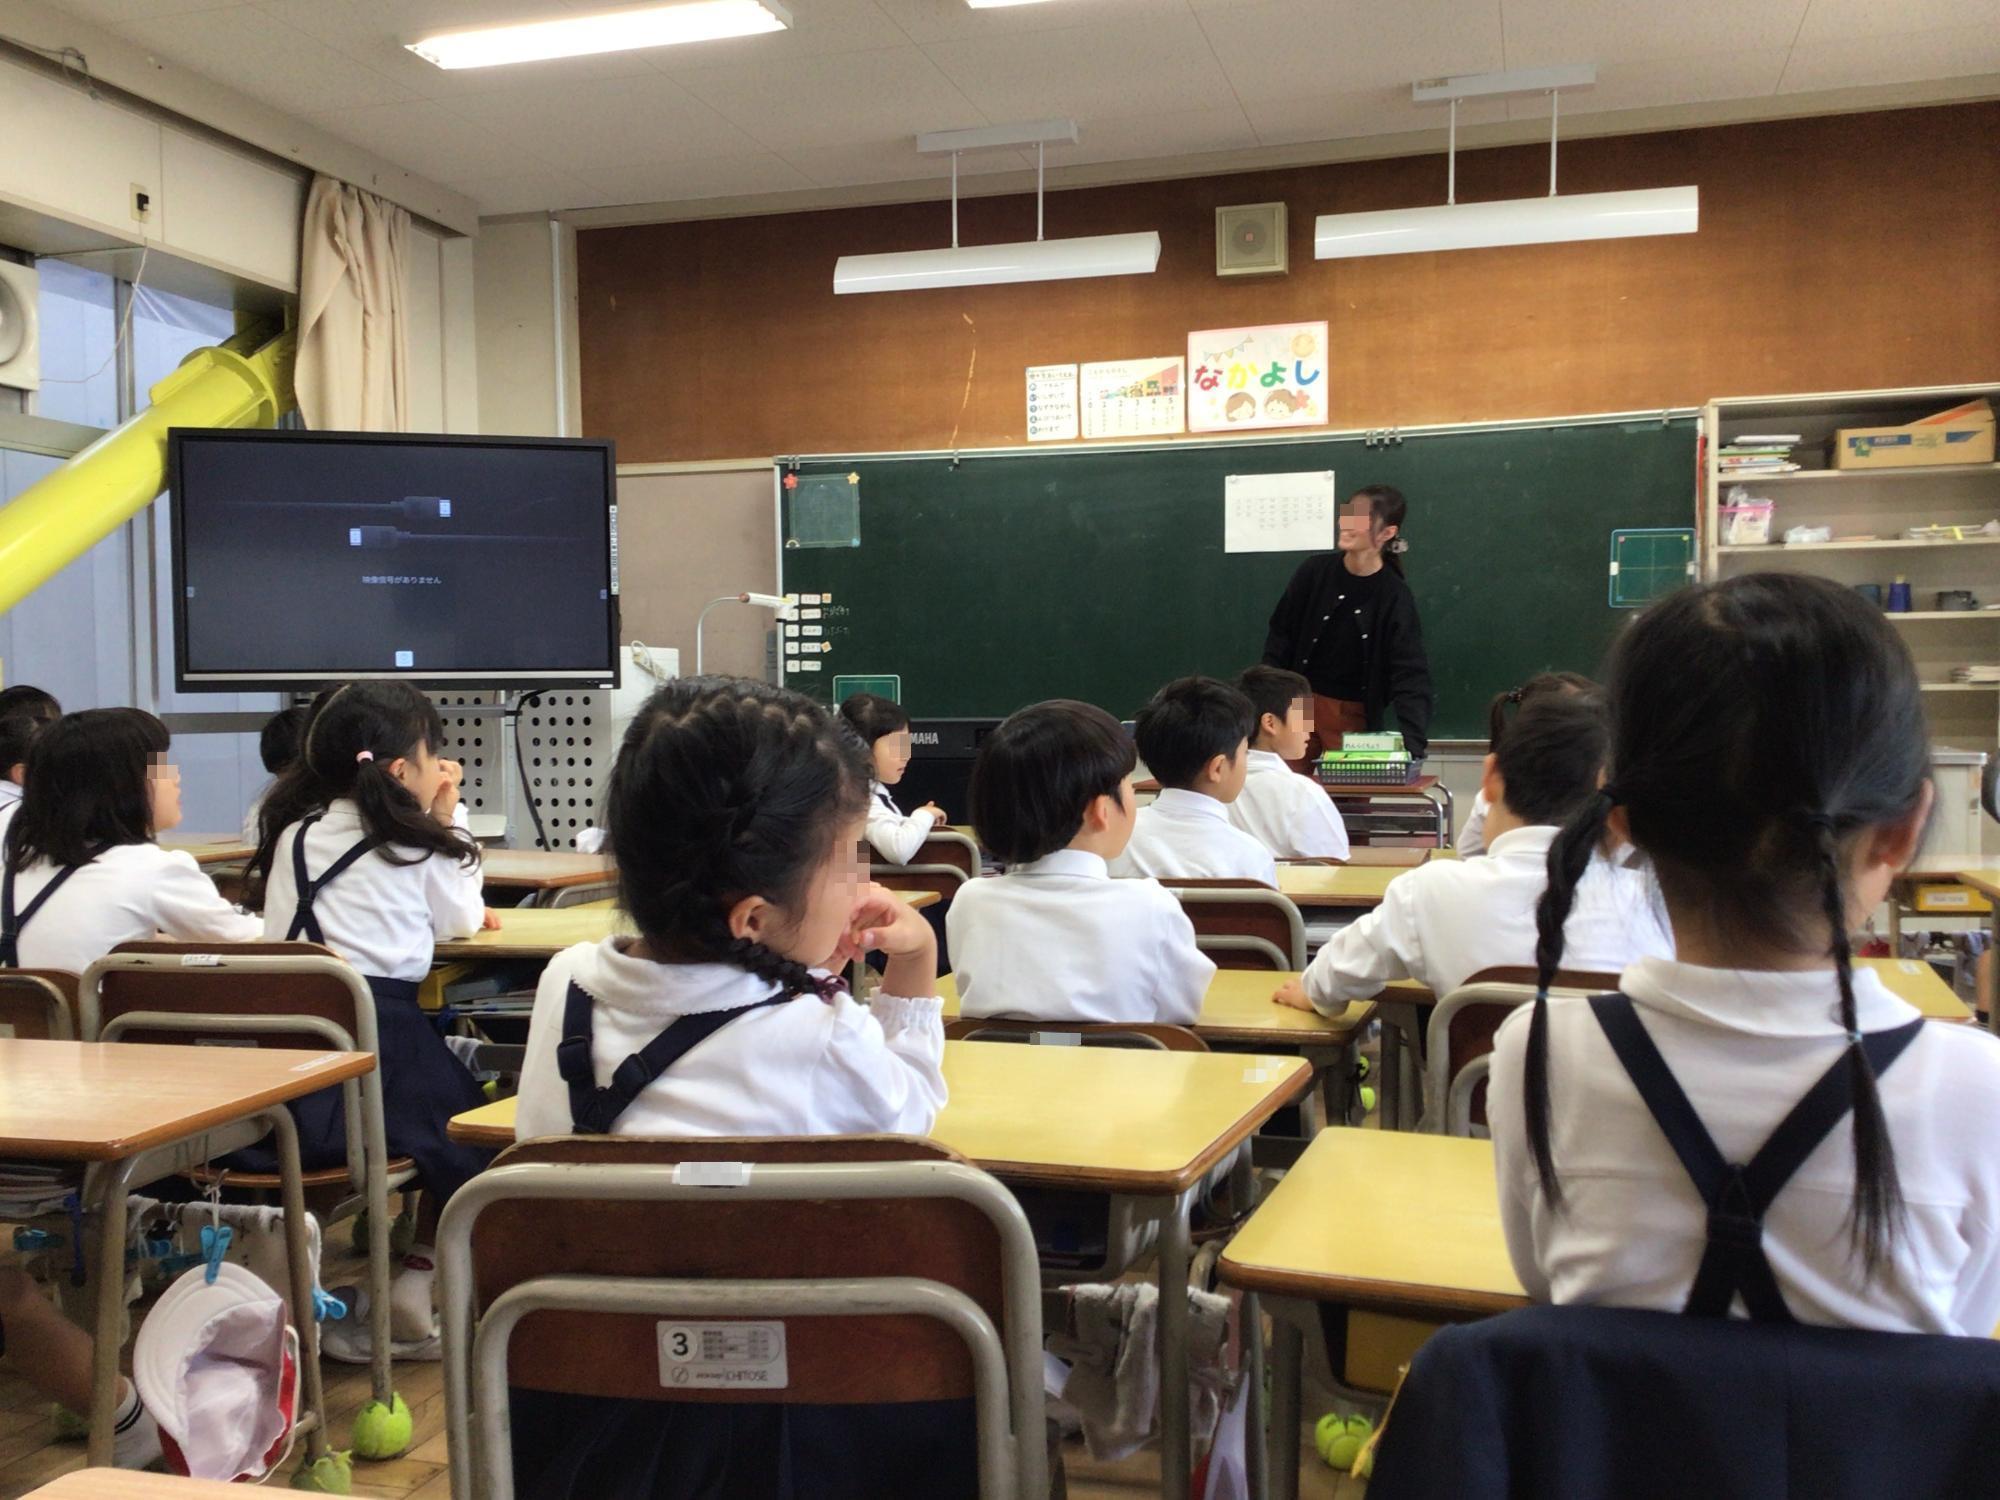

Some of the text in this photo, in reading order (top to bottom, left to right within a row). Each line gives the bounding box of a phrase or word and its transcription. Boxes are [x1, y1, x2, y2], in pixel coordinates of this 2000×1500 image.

[1194, 360, 1320, 391] なかよし
[910, 732, 939, 745] MAHA
[672, 1332, 689, 1355] 3
